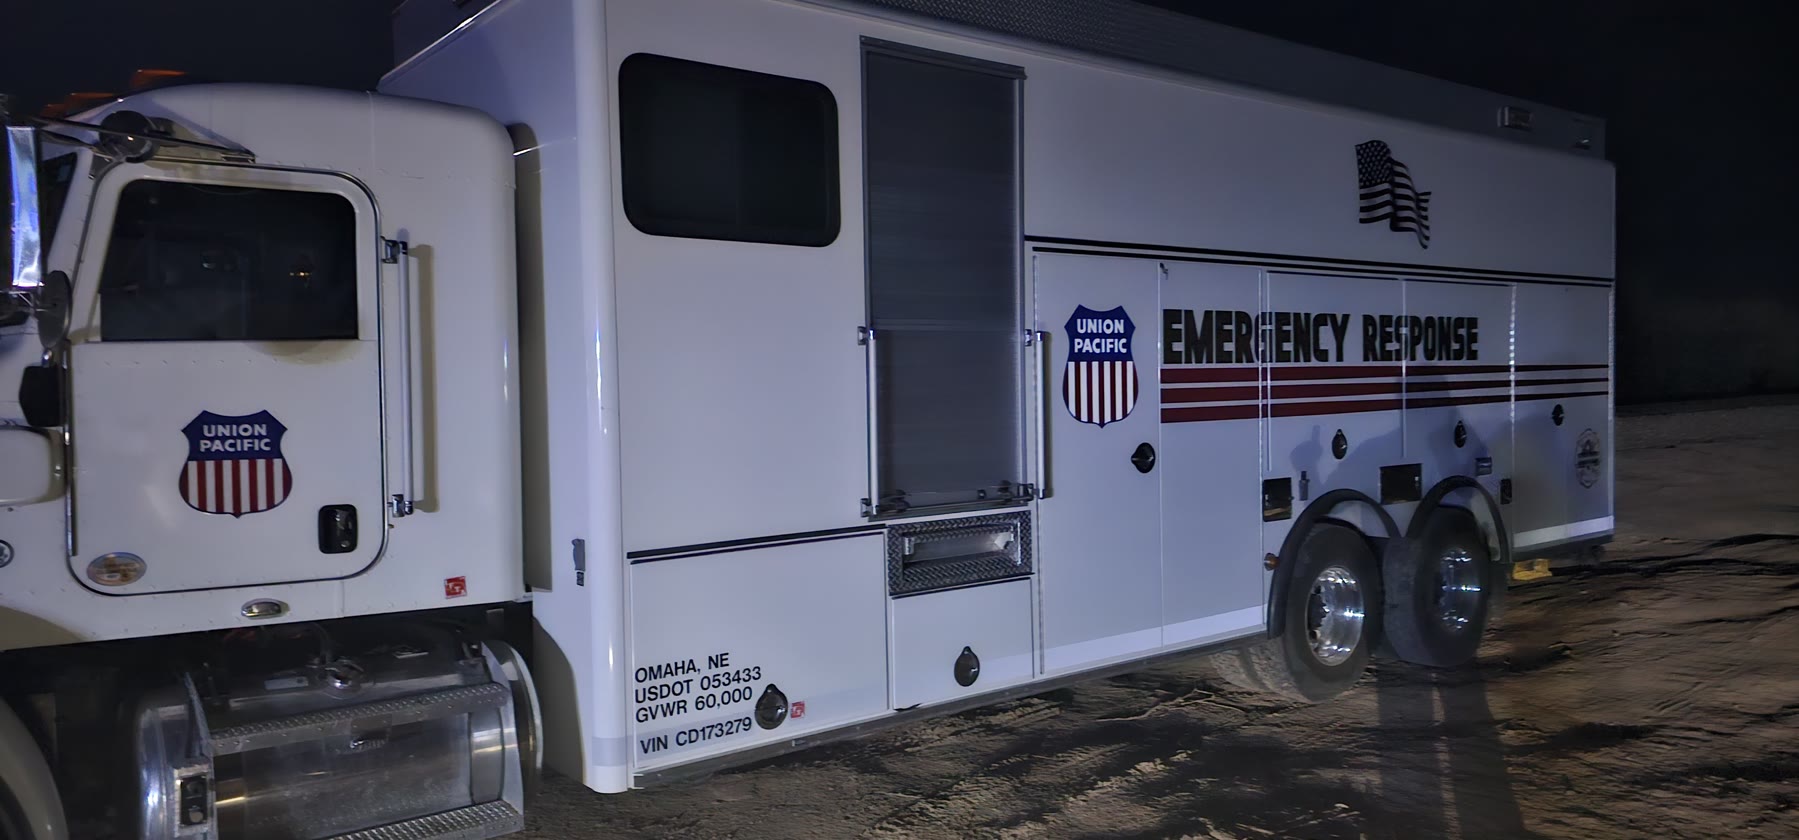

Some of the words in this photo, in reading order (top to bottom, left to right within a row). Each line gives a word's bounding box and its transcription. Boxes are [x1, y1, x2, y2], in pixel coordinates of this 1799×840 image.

[1076, 318, 1125, 334] UNION
[1162, 308, 1350, 364] EMERGENCY
[1362, 314, 1478, 362] RESPONSE
[1074, 338, 1128, 354] PACIFIC
[199, 438, 271, 452] PACIFIC
[202, 423, 267, 437] UNION
[635, 659, 701, 683] OMAHA,
[708, 652, 729, 670] NE
[635, 679, 694, 704] USDOT
[700, 666, 762, 691] 053433
[635, 700, 688, 723] GVWR
[695, 686, 753, 710] 60,000
[640, 734, 668, 754] VIN
[675, 716, 753, 747] CD173279
